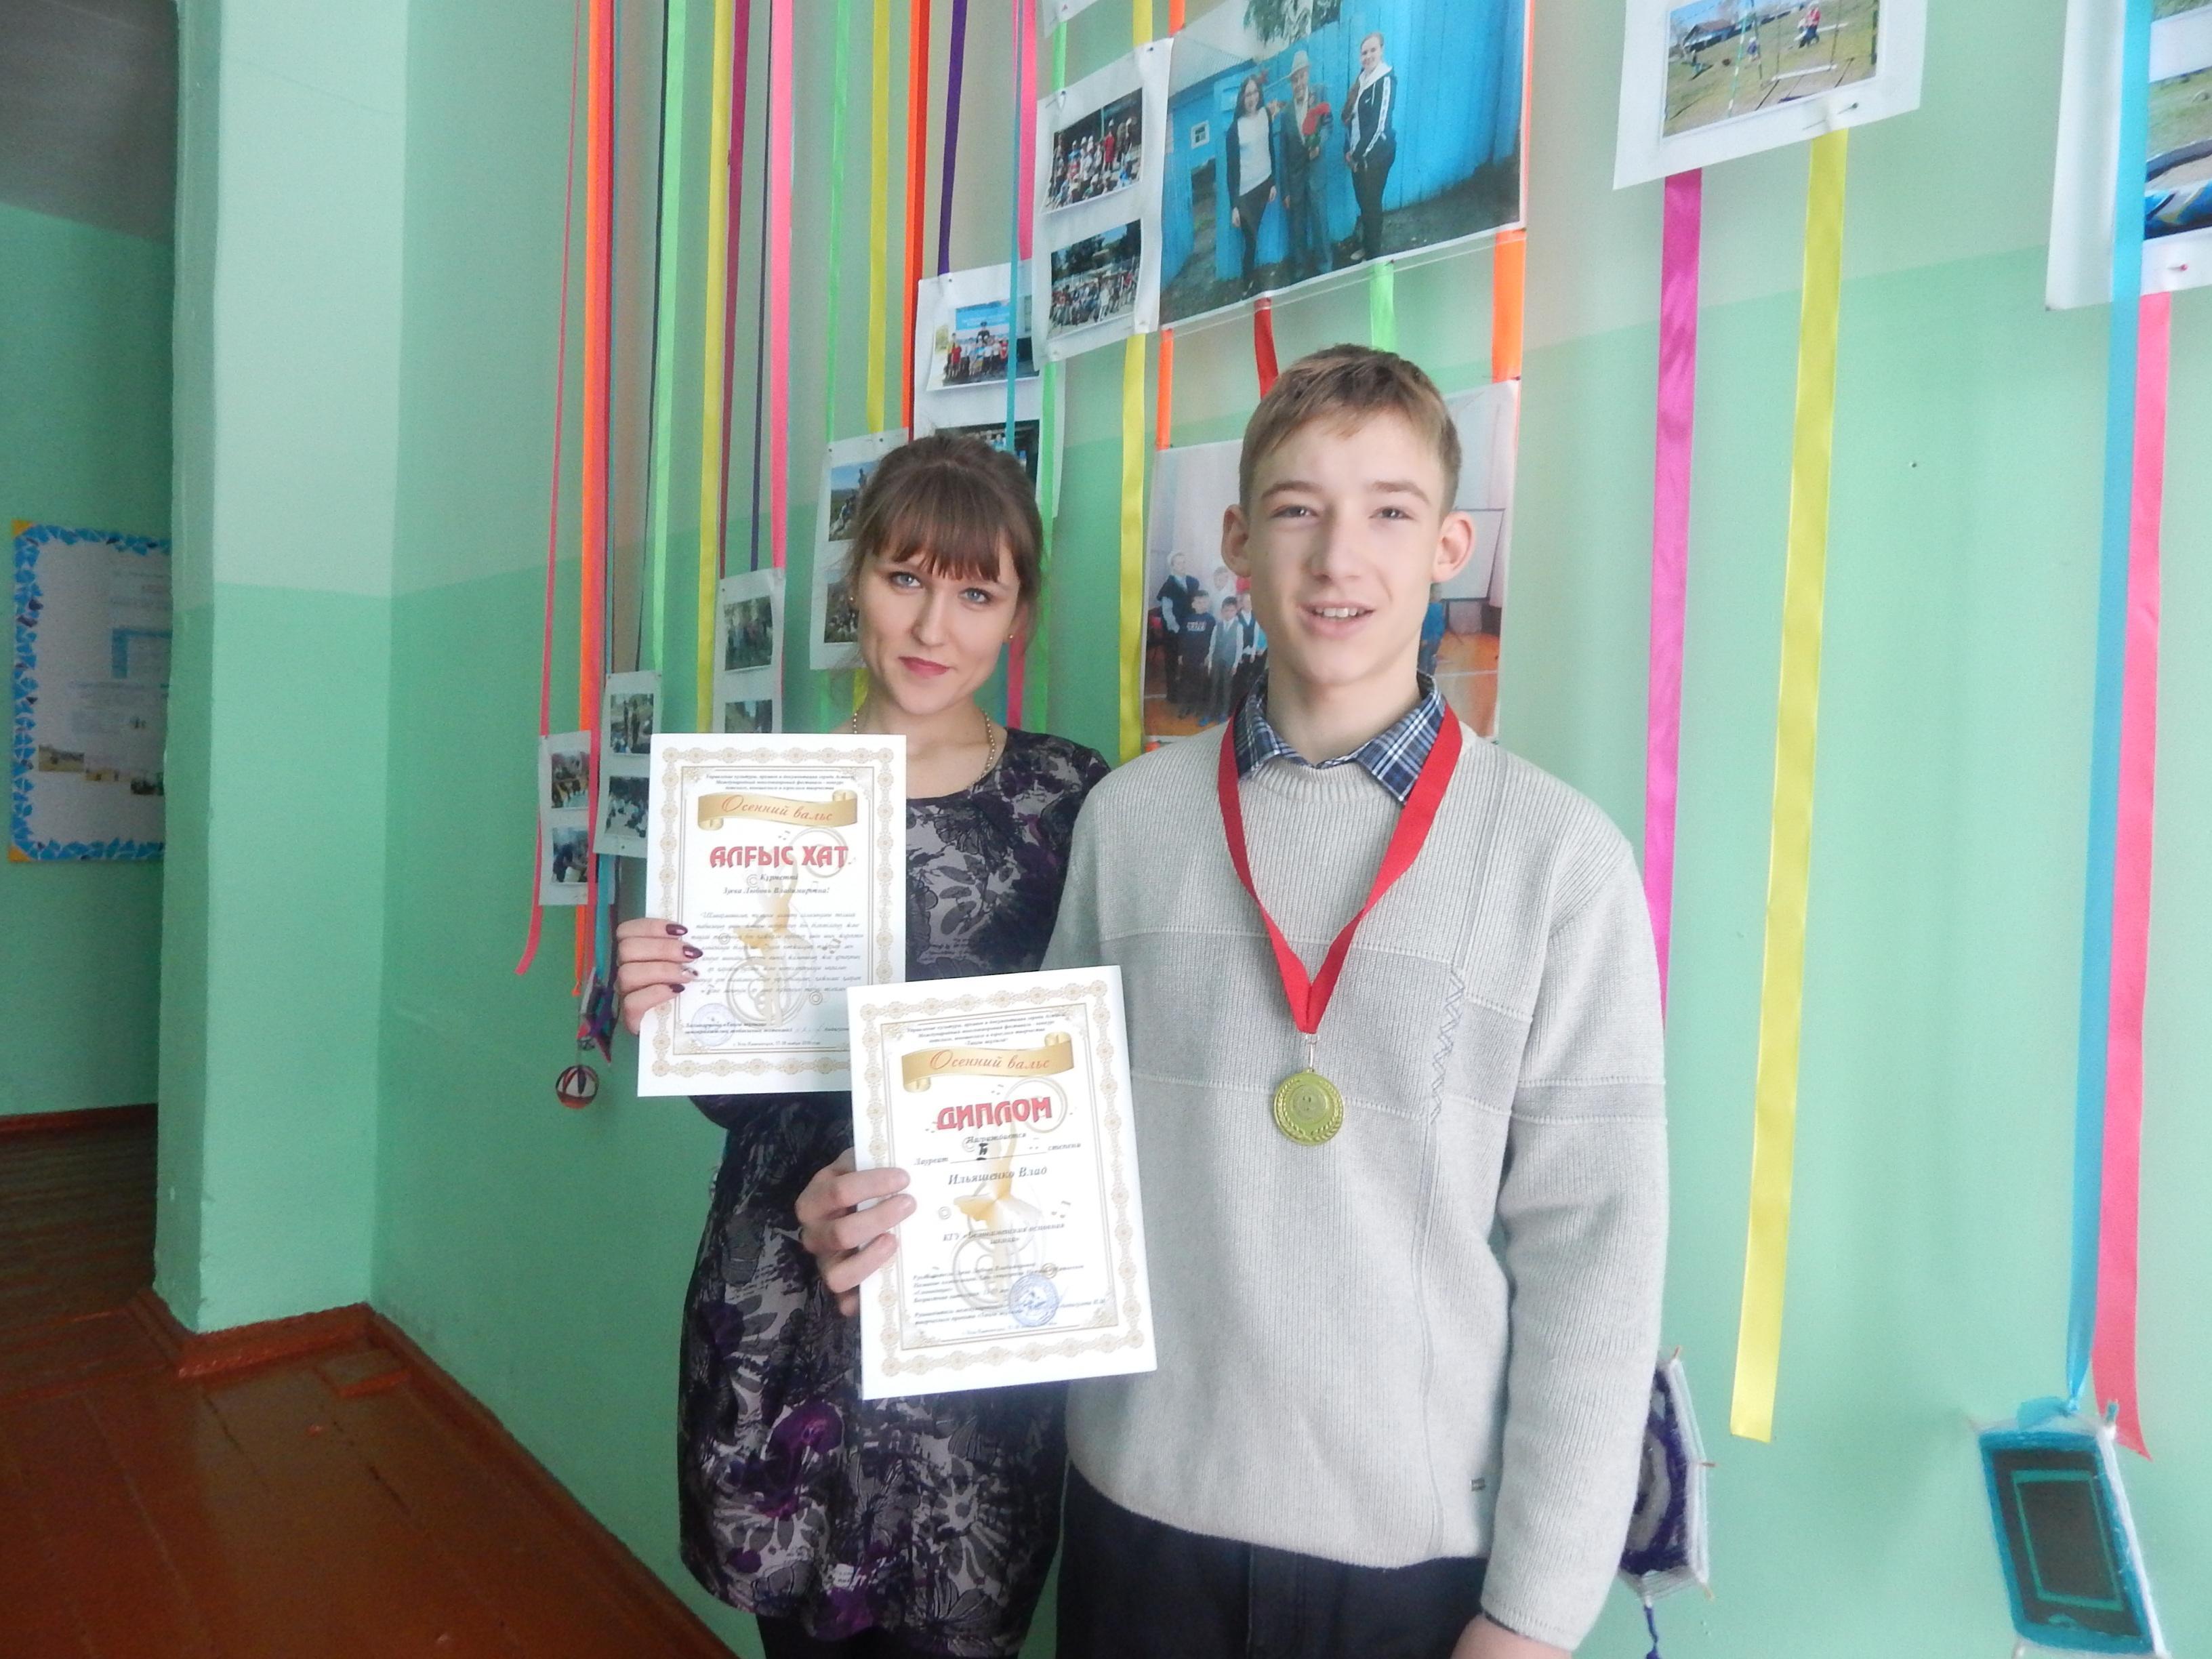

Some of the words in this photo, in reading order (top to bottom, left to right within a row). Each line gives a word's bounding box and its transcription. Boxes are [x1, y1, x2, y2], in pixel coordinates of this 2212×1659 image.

[722, 794, 788, 816] Осенний
[794, 806, 833, 821] вальс
[710, 845, 794, 868] АЛҒЫС
[801, 845, 849, 868] ХАТ
[929, 1049, 1002, 1070] Осенний
[1008, 1054, 1050, 1069] вальс
[936, 1096, 1053, 1132] ДИПЛОМ
[948, 1170, 1015, 1185] Ильяшенко
[1019, 1166, 1048, 1178] Влад
